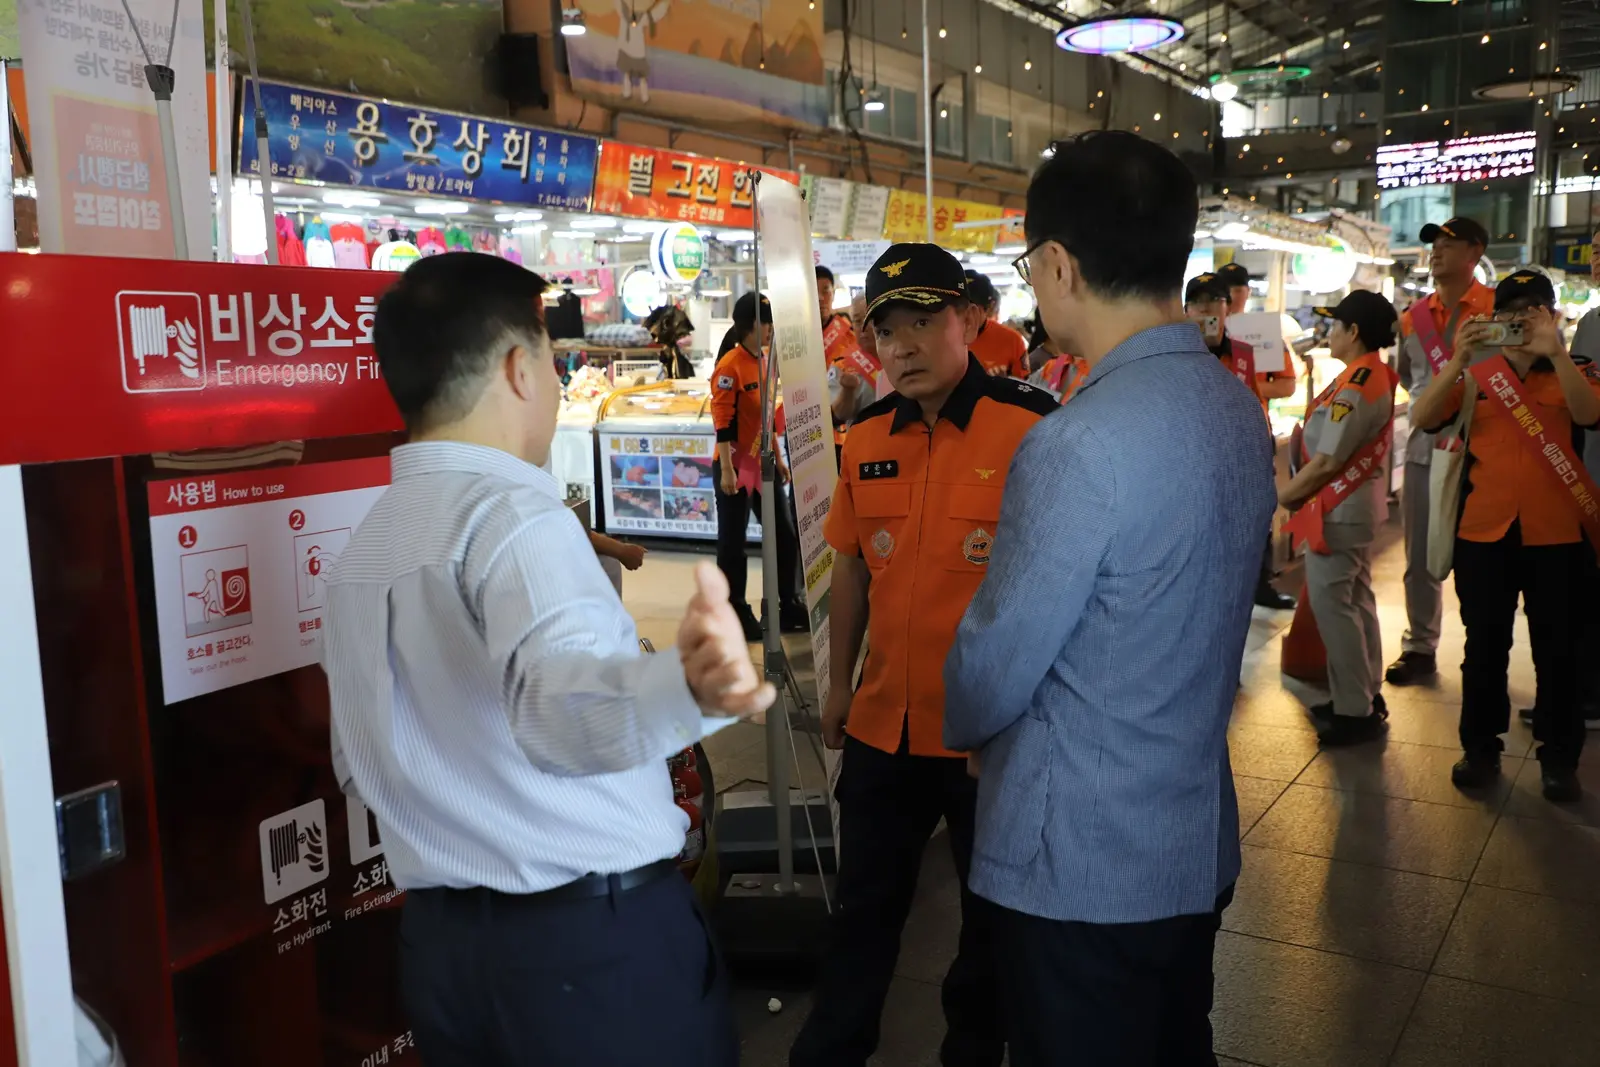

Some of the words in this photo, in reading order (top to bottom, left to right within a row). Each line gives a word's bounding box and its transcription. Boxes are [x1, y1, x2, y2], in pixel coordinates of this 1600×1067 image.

[348, 102, 531, 179] 용호상회
[216, 355, 349, 388] Emergency
[356, 355, 381, 381] Fir
[167, 480, 217, 507] 사용법
[223, 487, 248, 500] How
[251, 487, 263, 497] to
[266, 483, 285, 495] use
[353, 860, 389, 897] 소화
[273, 888, 328, 934] 소화전
[344, 906, 362, 921] Fire
[277, 941, 292, 955] ire
[293, 920, 332, 946] Hydrant
